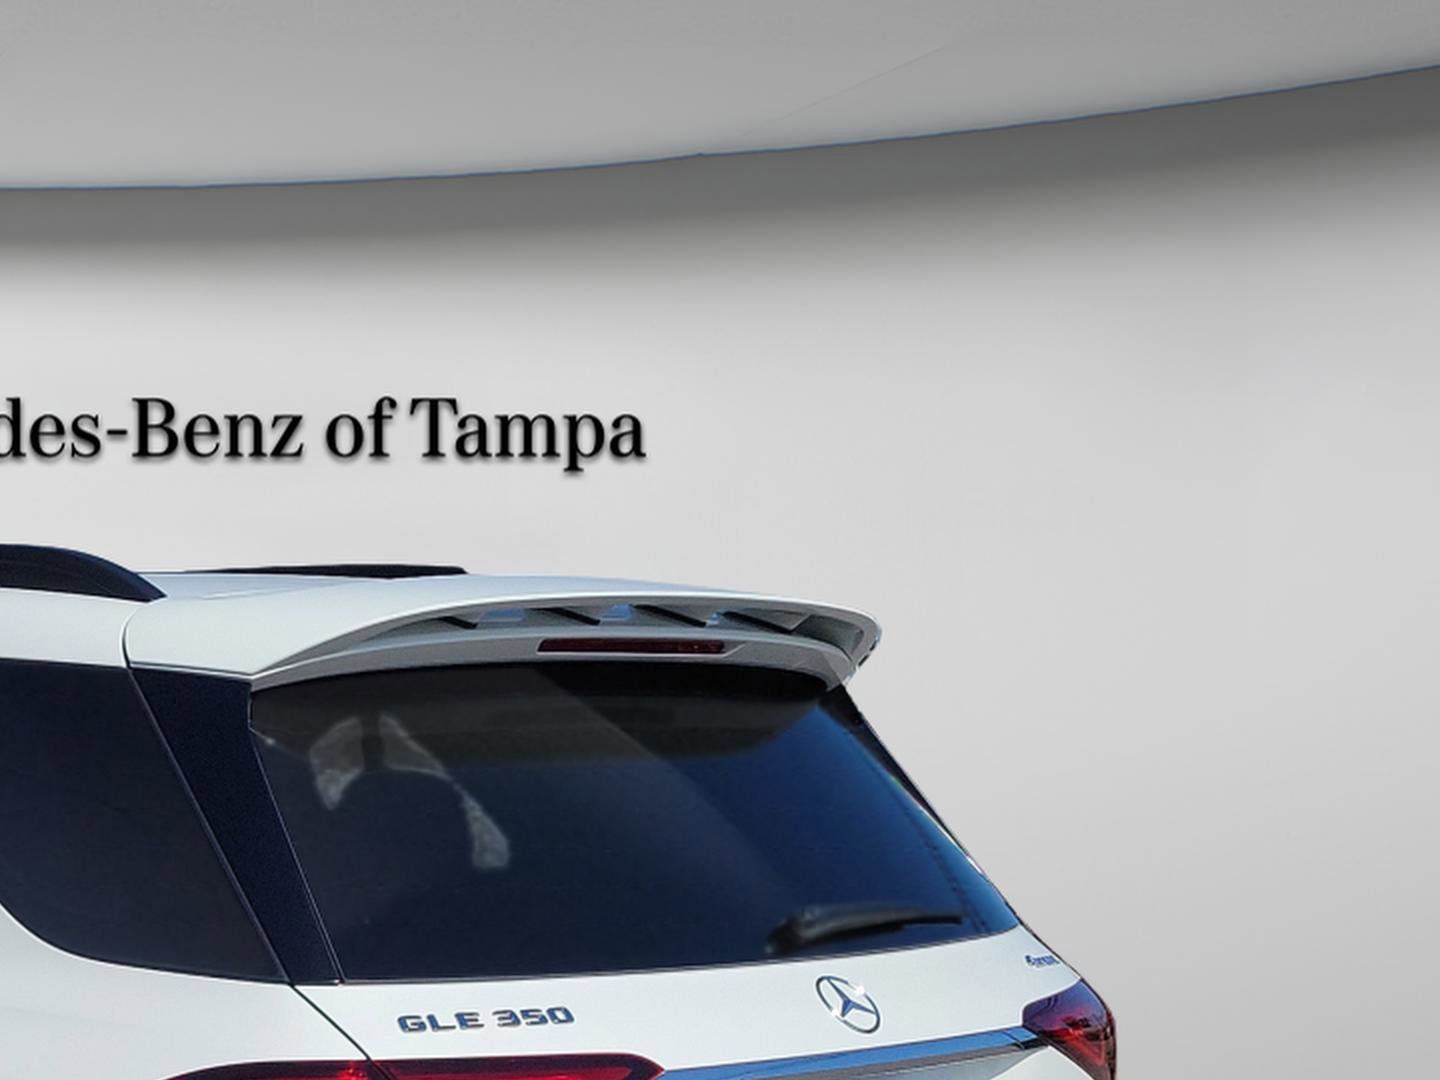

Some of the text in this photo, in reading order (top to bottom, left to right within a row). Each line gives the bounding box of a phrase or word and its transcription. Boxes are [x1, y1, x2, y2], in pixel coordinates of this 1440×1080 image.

[325, 396, 398, 460] of
[409, 397, 647, 474] Tampa
[397, 1006, 575, 1033] GLE 350
